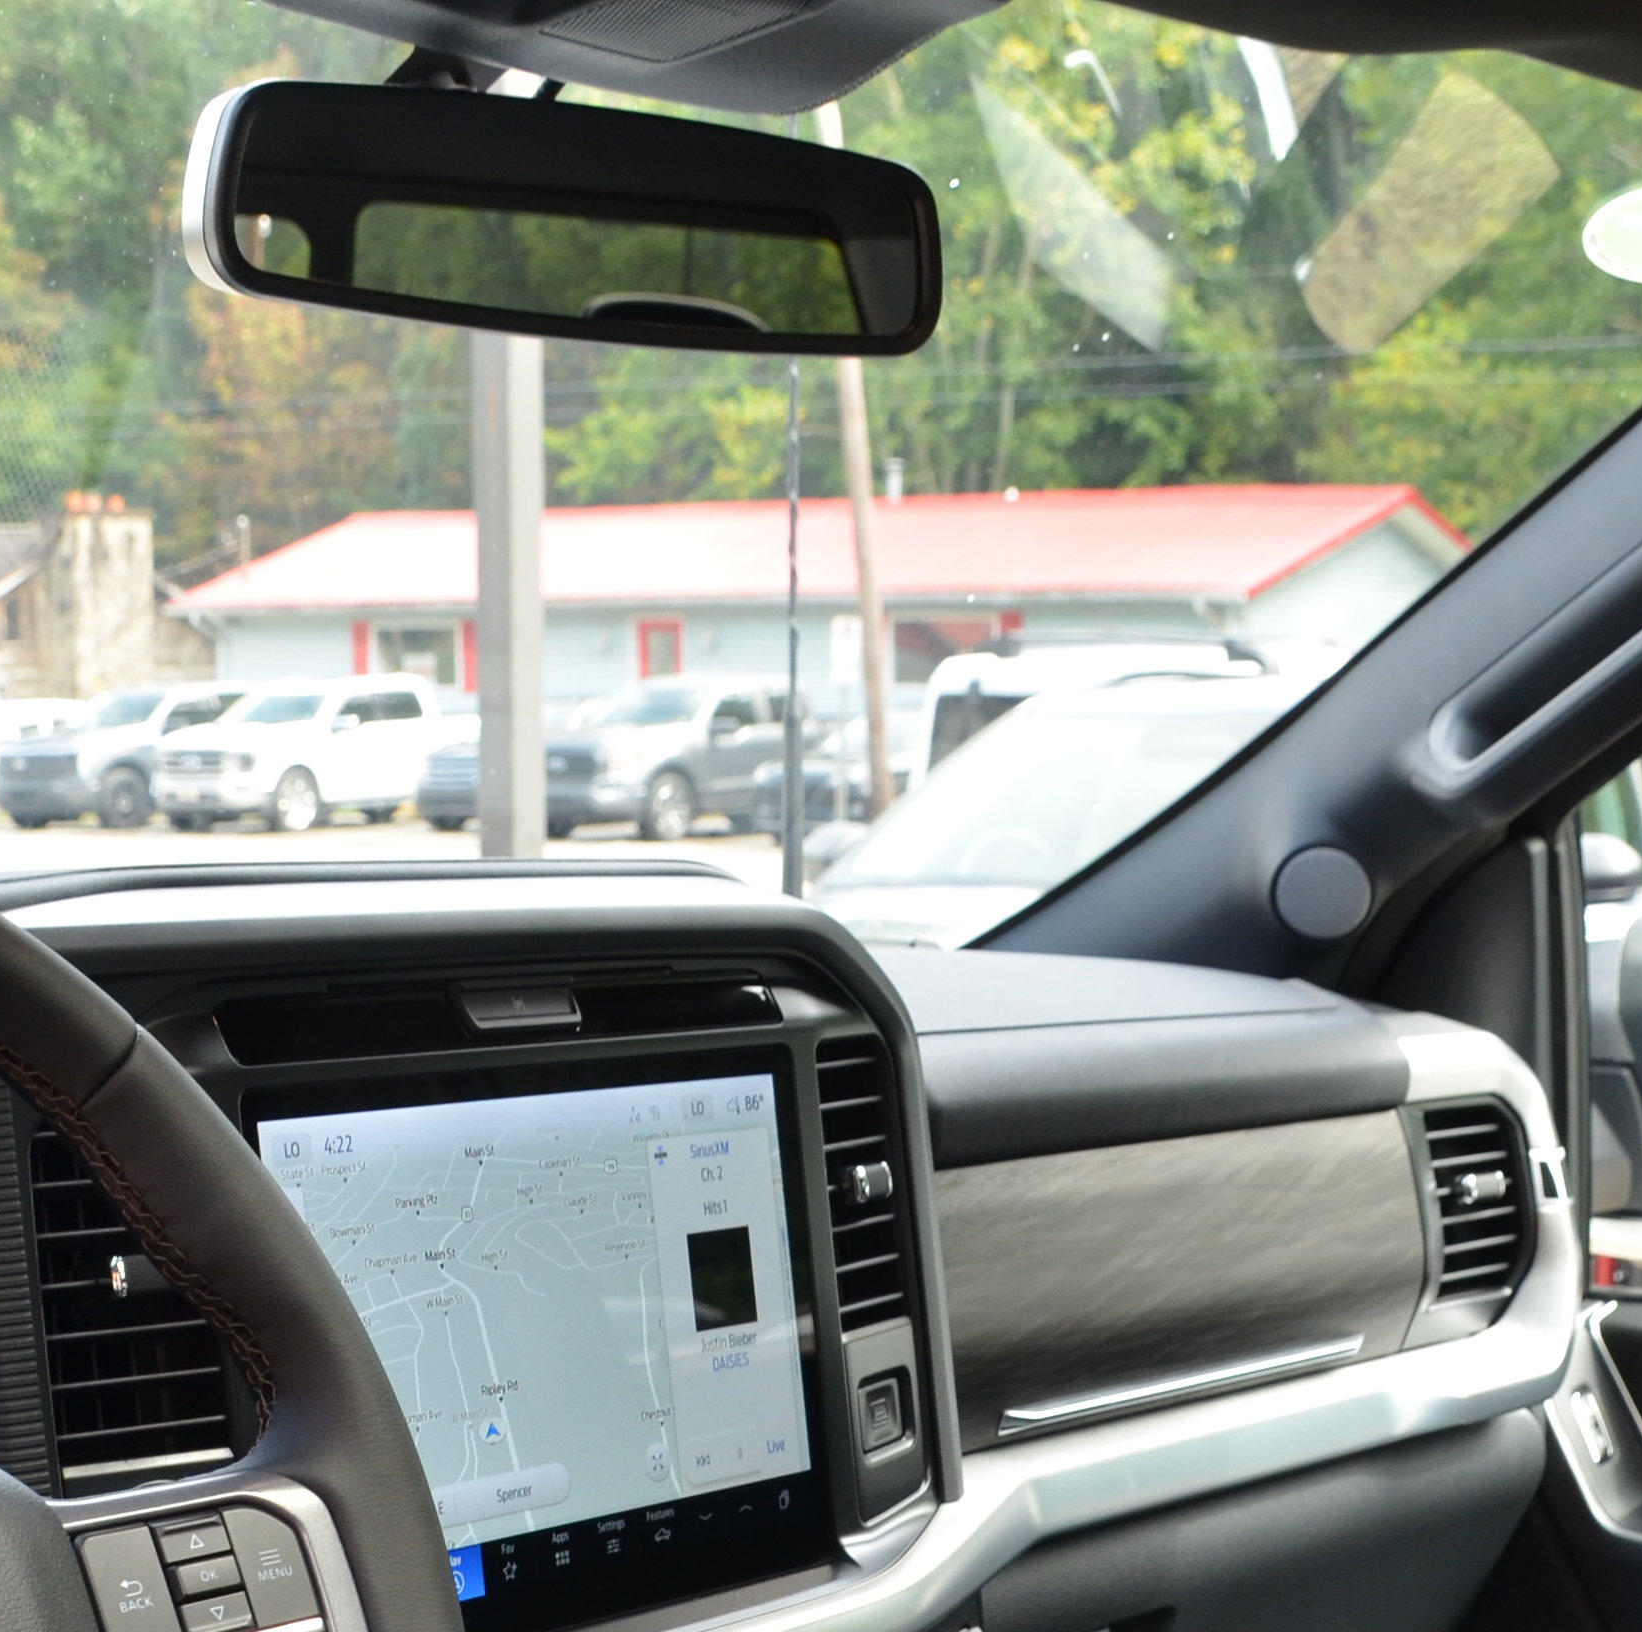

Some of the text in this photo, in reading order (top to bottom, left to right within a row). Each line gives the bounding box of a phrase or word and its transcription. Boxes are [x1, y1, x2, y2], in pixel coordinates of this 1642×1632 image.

[324, 1134, 354, 1155] 4:22
[464, 1145, 495, 1158] Main St
[689, 1140, 730, 1159] SiriusXM
[281, 1166, 315, 1181] State St
[321, 1161, 367, 1177] Prospect St
[395, 1196, 425, 1212] Parking
[703, 1199, 723, 1216] Hits
[329, 1223, 375, 1239] Bowman St
[364, 1254, 418, 1270] Chapman Ave
[424, 1247, 456, 1262] Main St
[481, 1249, 508, 1264] High St
[343, 1273, 359, 1285] Ave
[700, 1332, 757, 1353] Justin Bieber
[712, 1351, 750, 1371] DAISIES
[481, 1379, 519, 1397] Ripley Rd
[766, 1439, 786, 1455] Live
[495, 1485, 533, 1504] Spencer
[645, 1507, 675, 1523] Features
[597, 1517, 625, 1534] Settings
[551, 1530, 570, 1546] Apps
[501, 1543, 515, 1556] Fav
[200, 1568, 220, 1583] OK
[257, 1565, 294, 1582] MENU
[118, 1596, 154, 1614] BACK
